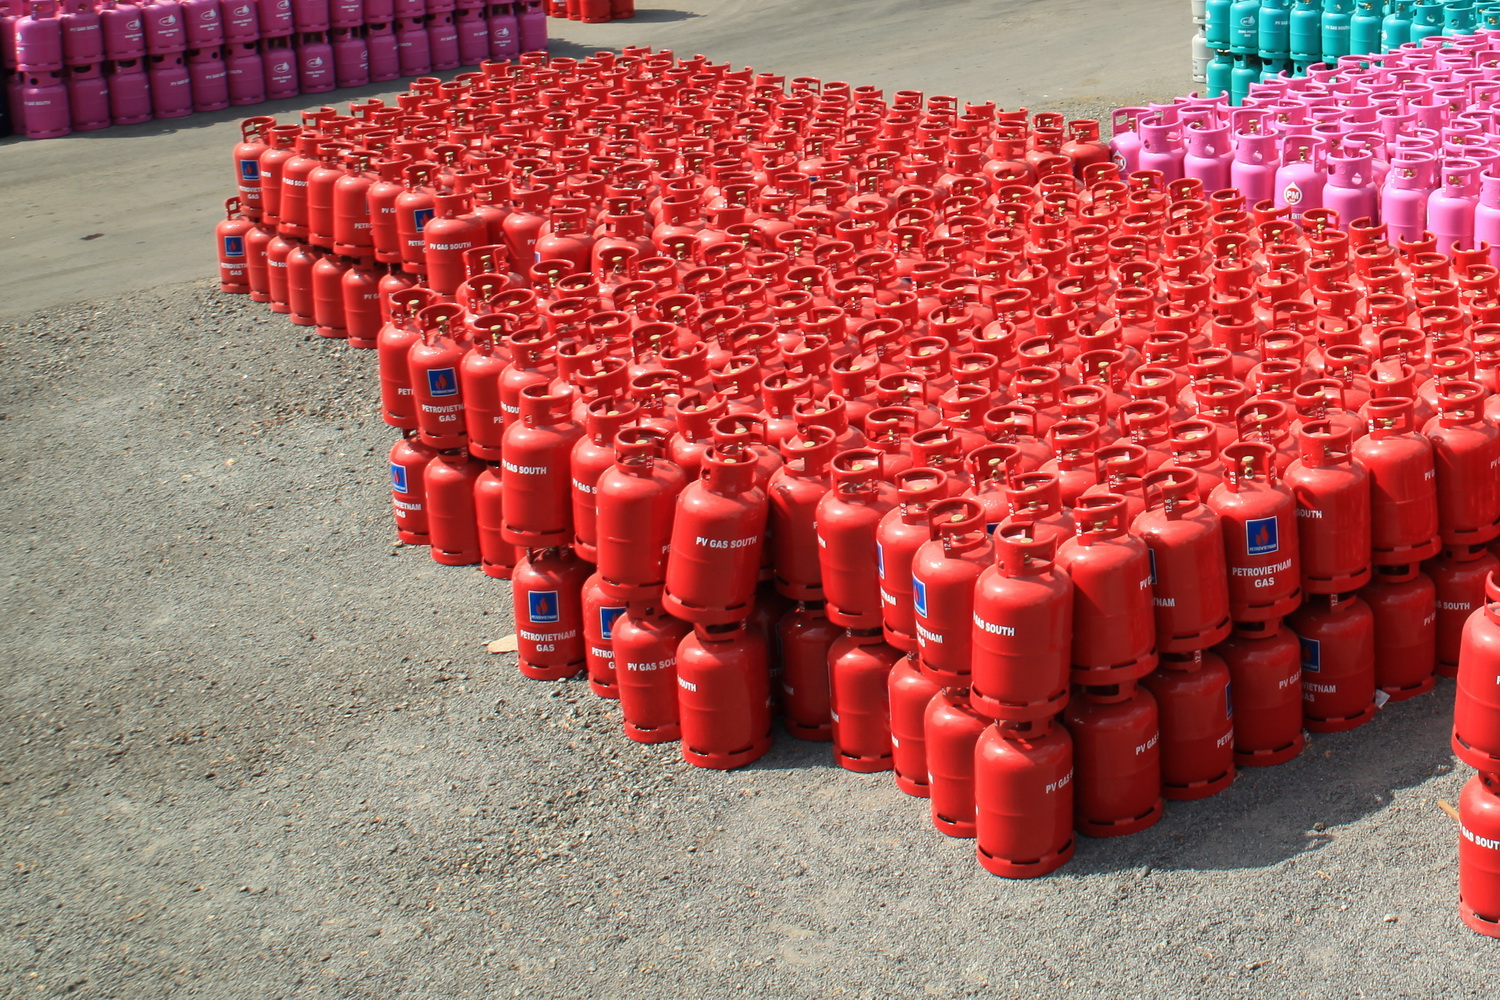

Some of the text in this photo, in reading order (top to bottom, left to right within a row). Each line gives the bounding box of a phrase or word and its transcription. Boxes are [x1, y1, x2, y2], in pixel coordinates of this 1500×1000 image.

[1286, 190, 1299, 199] PM
[451, 241, 472, 250] SOUTH
[439, 415, 456, 423] GAS
[507, 464, 518, 472] GAS
[519, 465, 547, 475] SOUTH
[579, 484, 590, 493] GAS
[1297, 510, 1323, 518] SOUTH
[696, 536, 757, 548] PV GAS SOUTH
[1249, 544, 1276, 552] PETROVIETNAM
[1232, 558, 1291, 576] PETROVIETNAM
[1140, 580, 1147, 590] PV
[1255, 578, 1274, 588] GAS
[1444, 602, 1470, 610] SOUTH
[986, 623, 1014, 636] SOUTH
[520, 629, 576, 642] PETROVIETNAM
[536, 644, 555, 652] GAS
[627, 662, 638, 670] PV
[640, 662, 657, 671] GAS
[1279, 680, 1288, 689] PV
[1136, 736, 1157, 755] PV GAS
[1046, 775, 1070, 793] PV GAS
